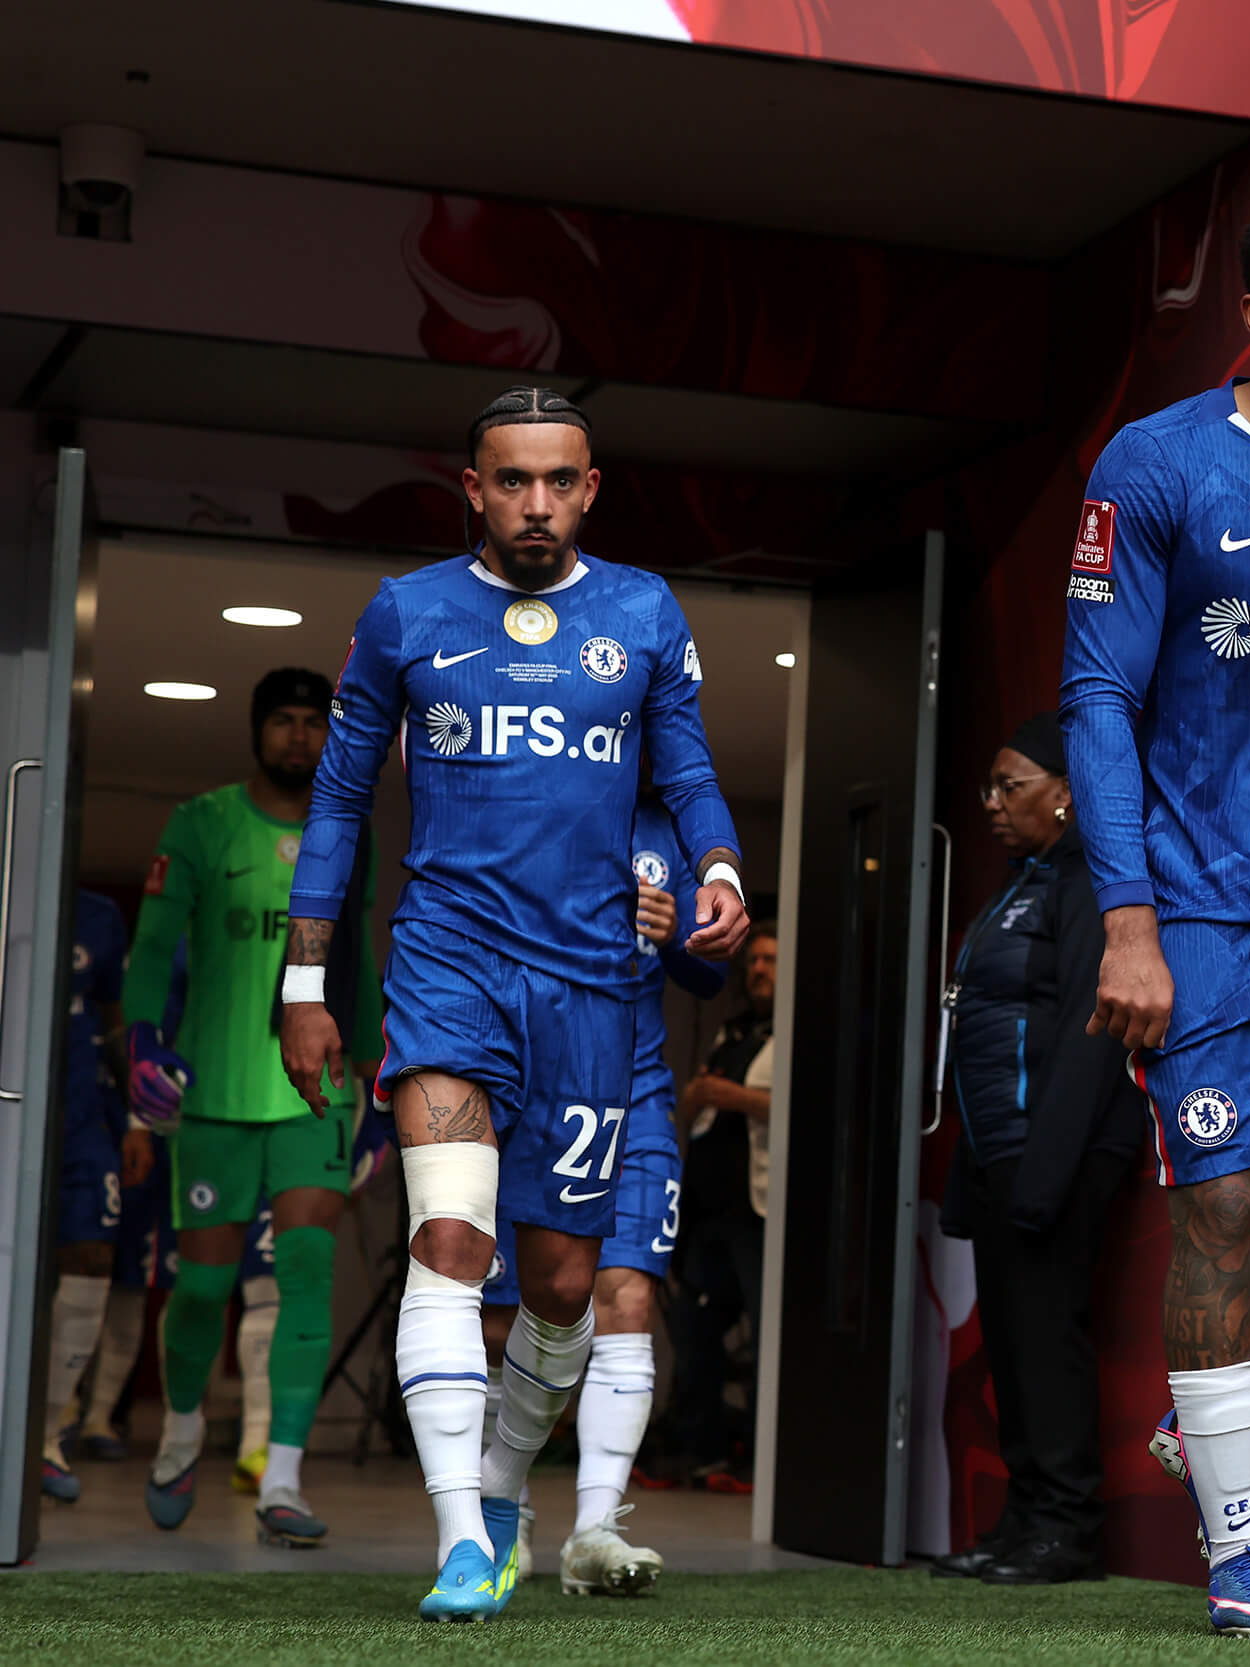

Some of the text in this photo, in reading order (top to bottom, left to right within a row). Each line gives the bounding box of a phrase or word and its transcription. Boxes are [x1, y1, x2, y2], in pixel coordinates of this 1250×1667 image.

[1075, 551, 1105, 564] FA CUP
[1077, 541, 1105, 554] Emirates
[1074, 588, 1114, 604] racism
[1077, 577, 1109, 592] room
[481, 704, 631, 764] IFS.ai
[1183, 1090, 1220, 1109] CHELSEA
[336, 1119, 346, 1161] 1
[552, 1104, 625, 1180] 27
[103, 1172, 122, 1216] 8
[661, 1178, 681, 1239] 3
